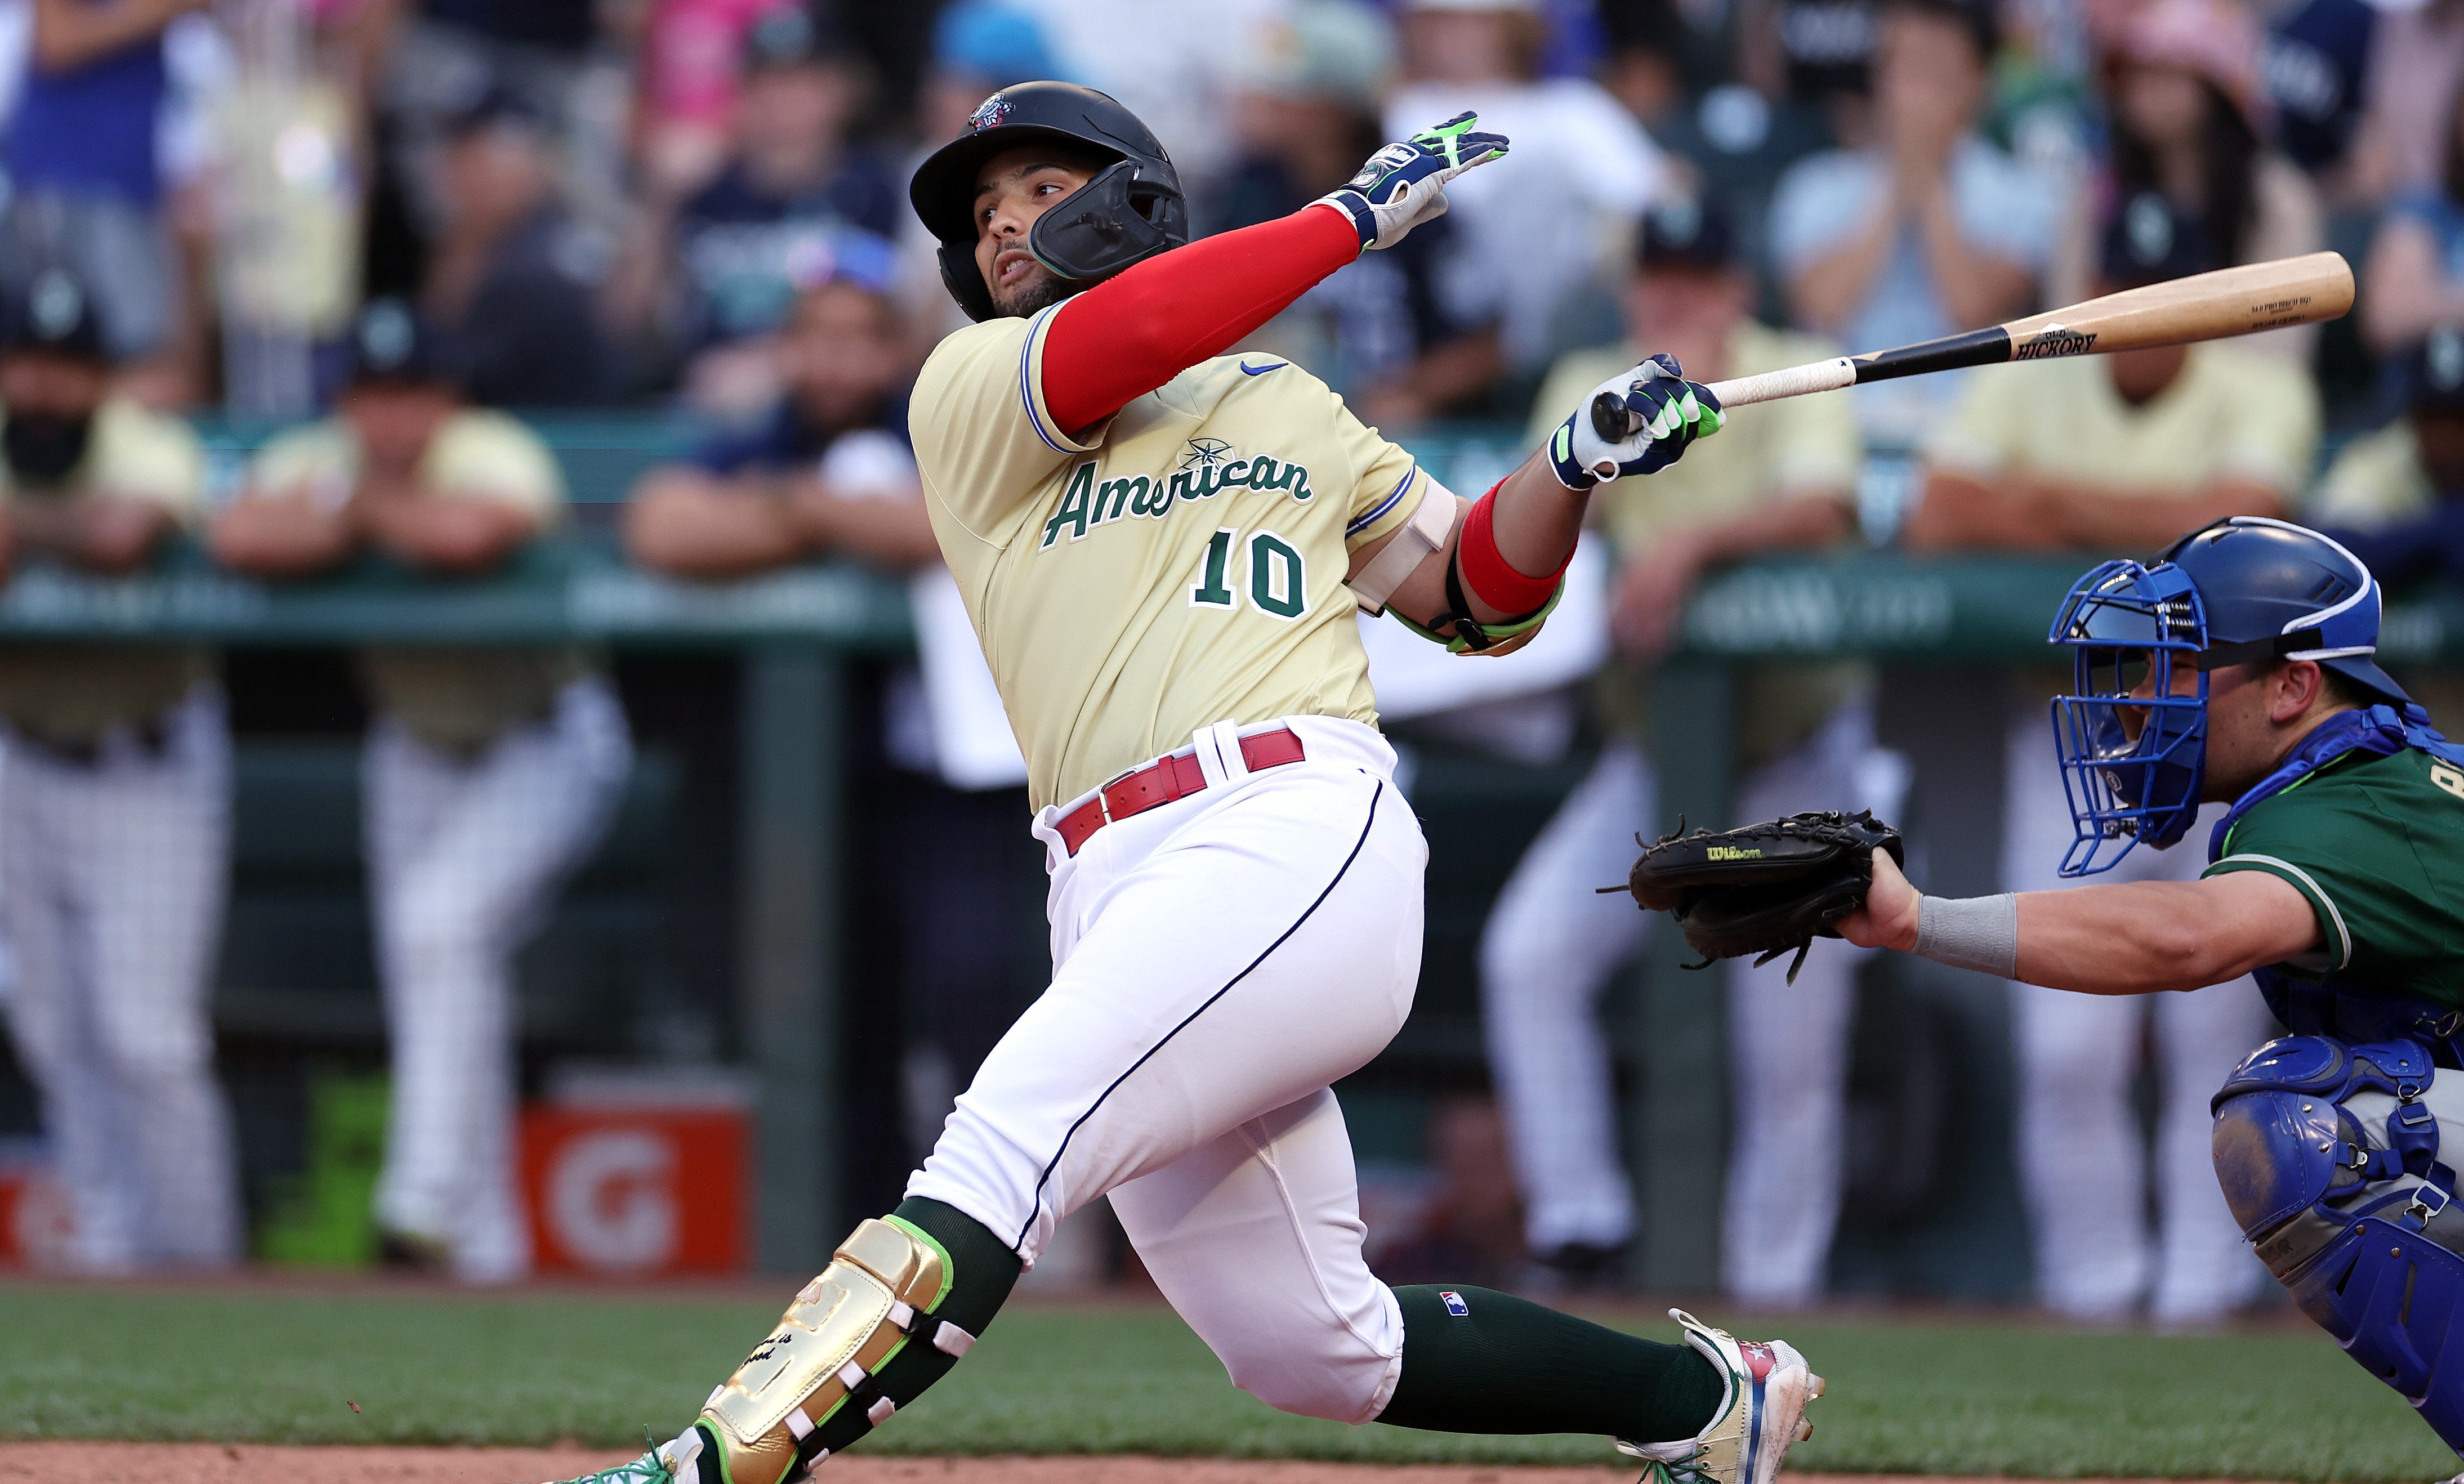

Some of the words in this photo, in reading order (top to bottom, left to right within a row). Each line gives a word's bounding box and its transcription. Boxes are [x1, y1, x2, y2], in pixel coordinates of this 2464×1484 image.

[2045, 330, 2066, 339] OLD
[2016, 333, 2097, 360] HICKORY
[1038, 453, 1314, 555] American
[1188, 526, 1311, 622] 10
[1706, 846, 1766, 861] Wilson
[778, 1334, 792, 1343] is
